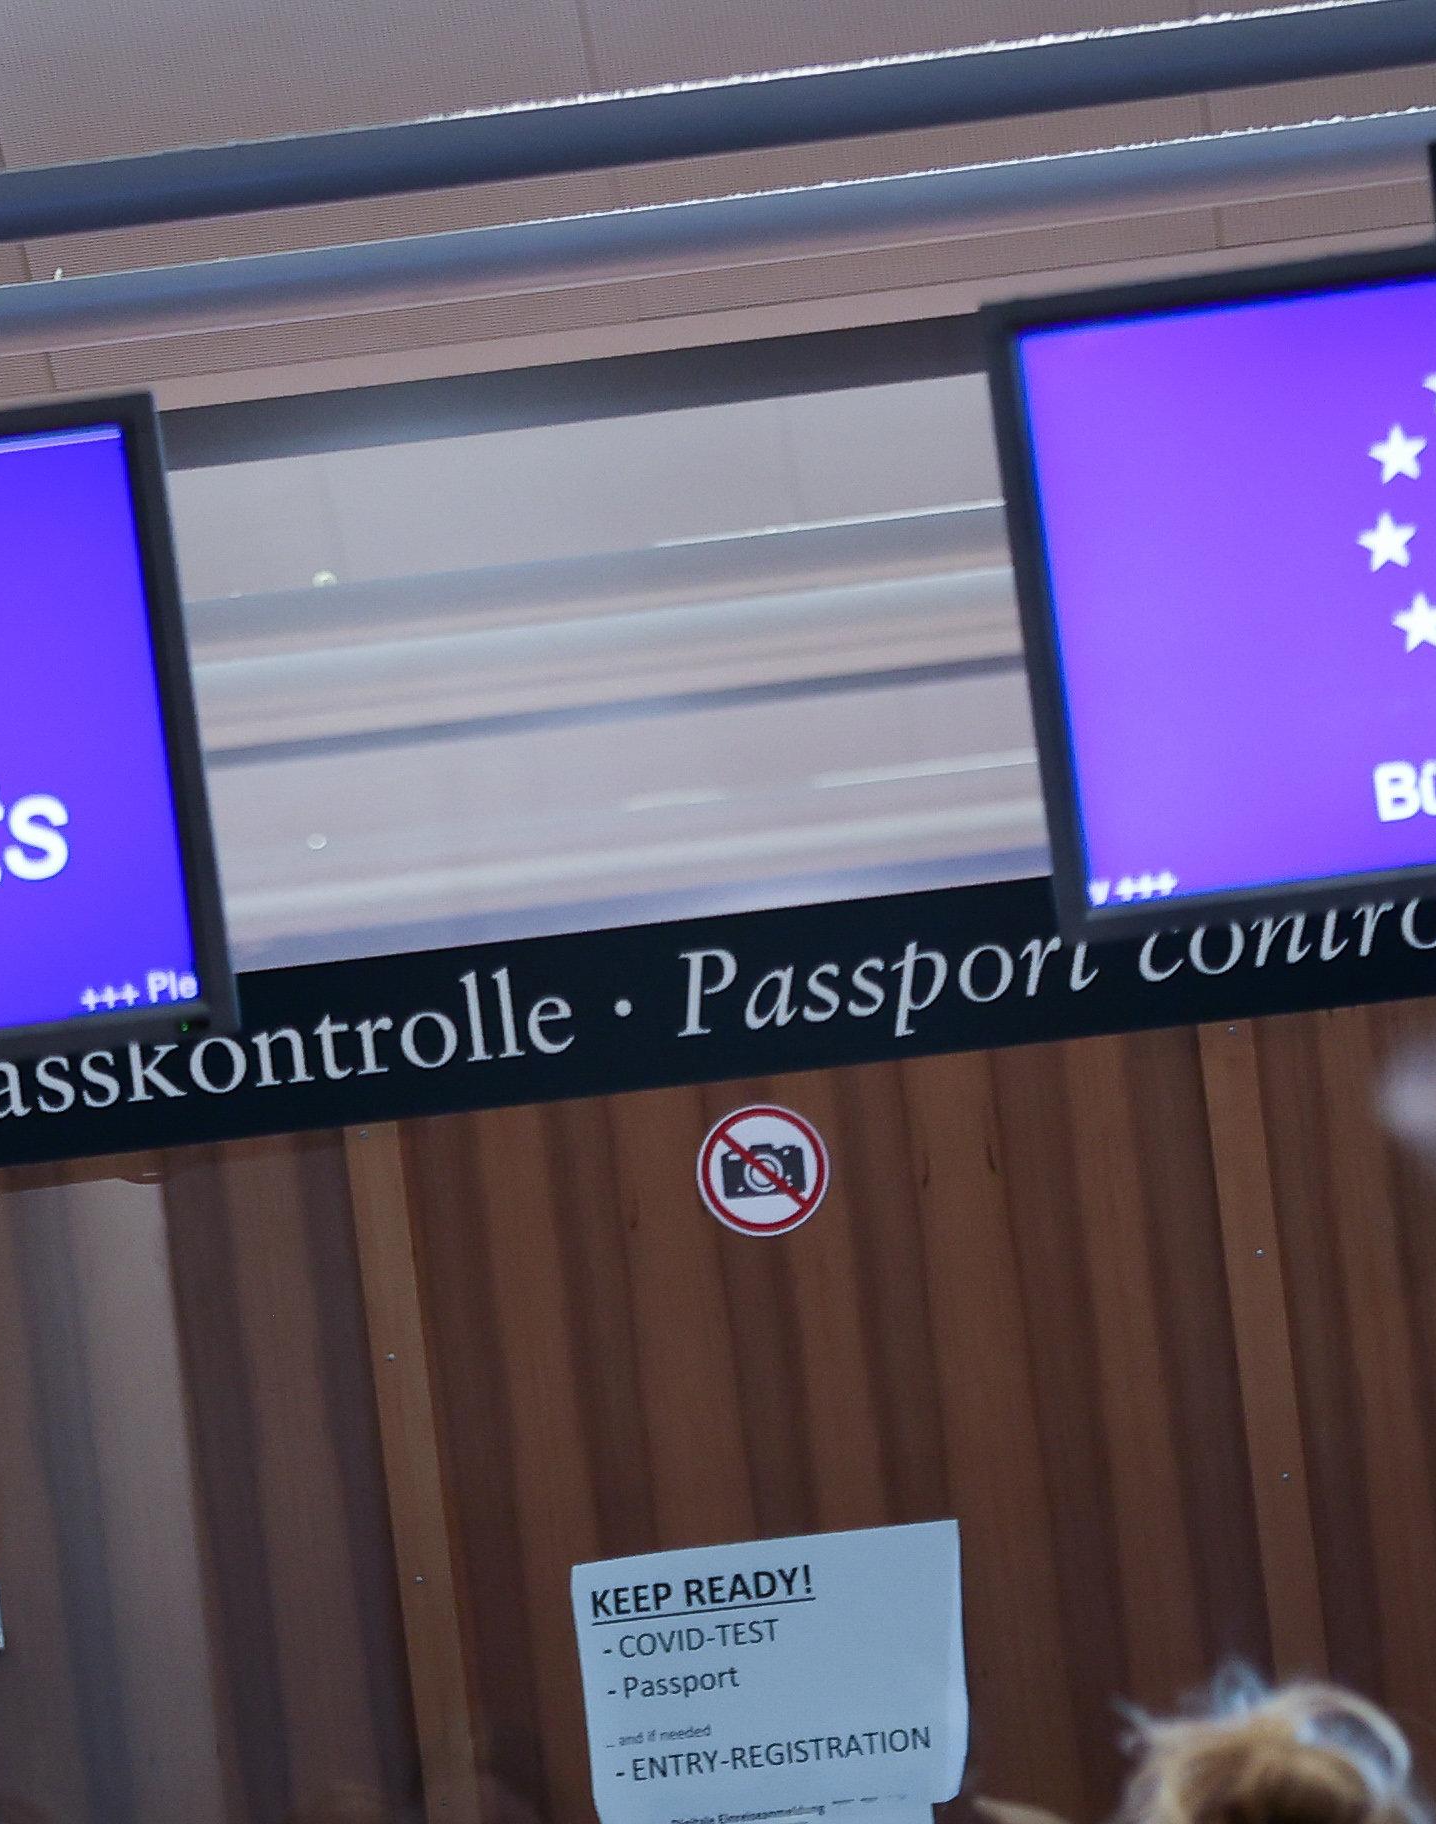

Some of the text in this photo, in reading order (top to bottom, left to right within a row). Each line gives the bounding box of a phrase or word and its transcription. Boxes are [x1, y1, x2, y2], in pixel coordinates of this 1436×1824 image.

[146, 969, 199, 1004] Ple
[677, 936, 1099, 1038] Passport
[591, 1564, 813, 1619] KEEP READY!
[619, 1618, 780, 1659] COVID-TEST
[623, 1666, 740, 1700] Passport
[660, 1723, 712, 1741] needed
[632, 1725, 931, 1781] ENTRY-REGISTRATION
